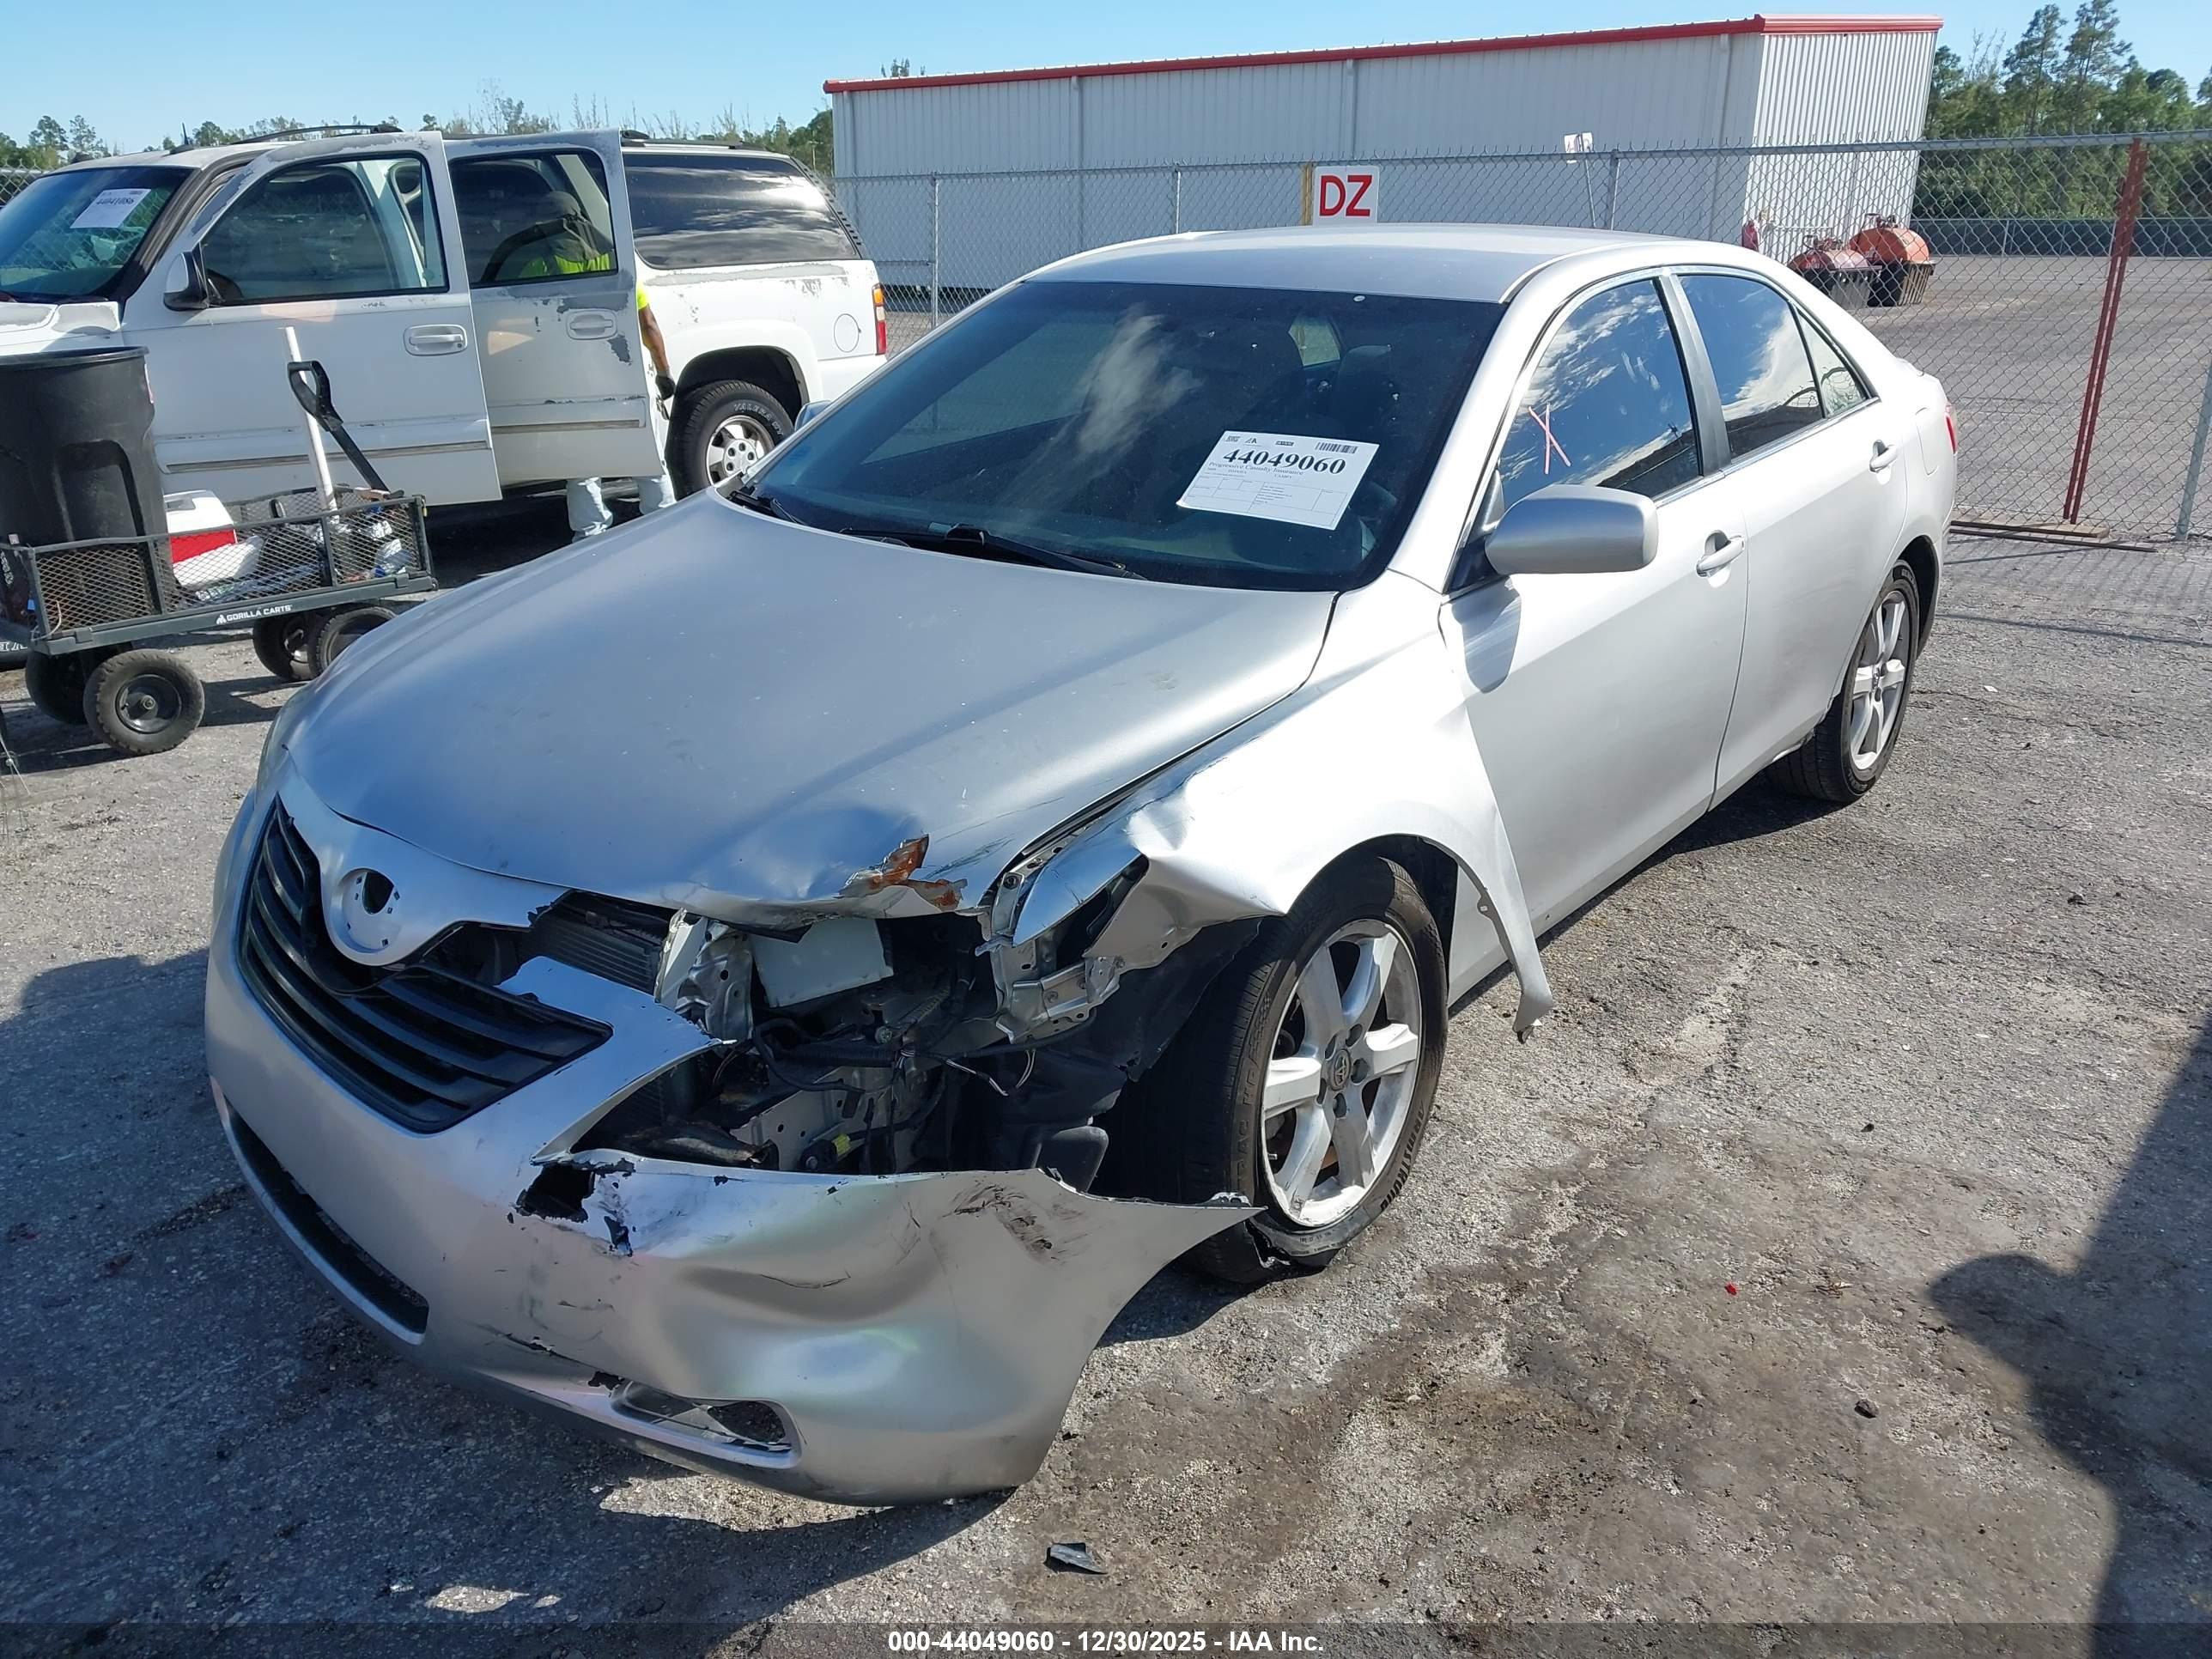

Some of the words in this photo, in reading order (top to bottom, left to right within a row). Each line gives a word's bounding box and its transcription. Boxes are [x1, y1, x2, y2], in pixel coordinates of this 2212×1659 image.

[1318, 174, 1374, 217] DZ
[1224, 448, 1346, 476] 44049060
[226, 611, 262, 622] GORILLA
[263, 605, 291, 615] CARTS
